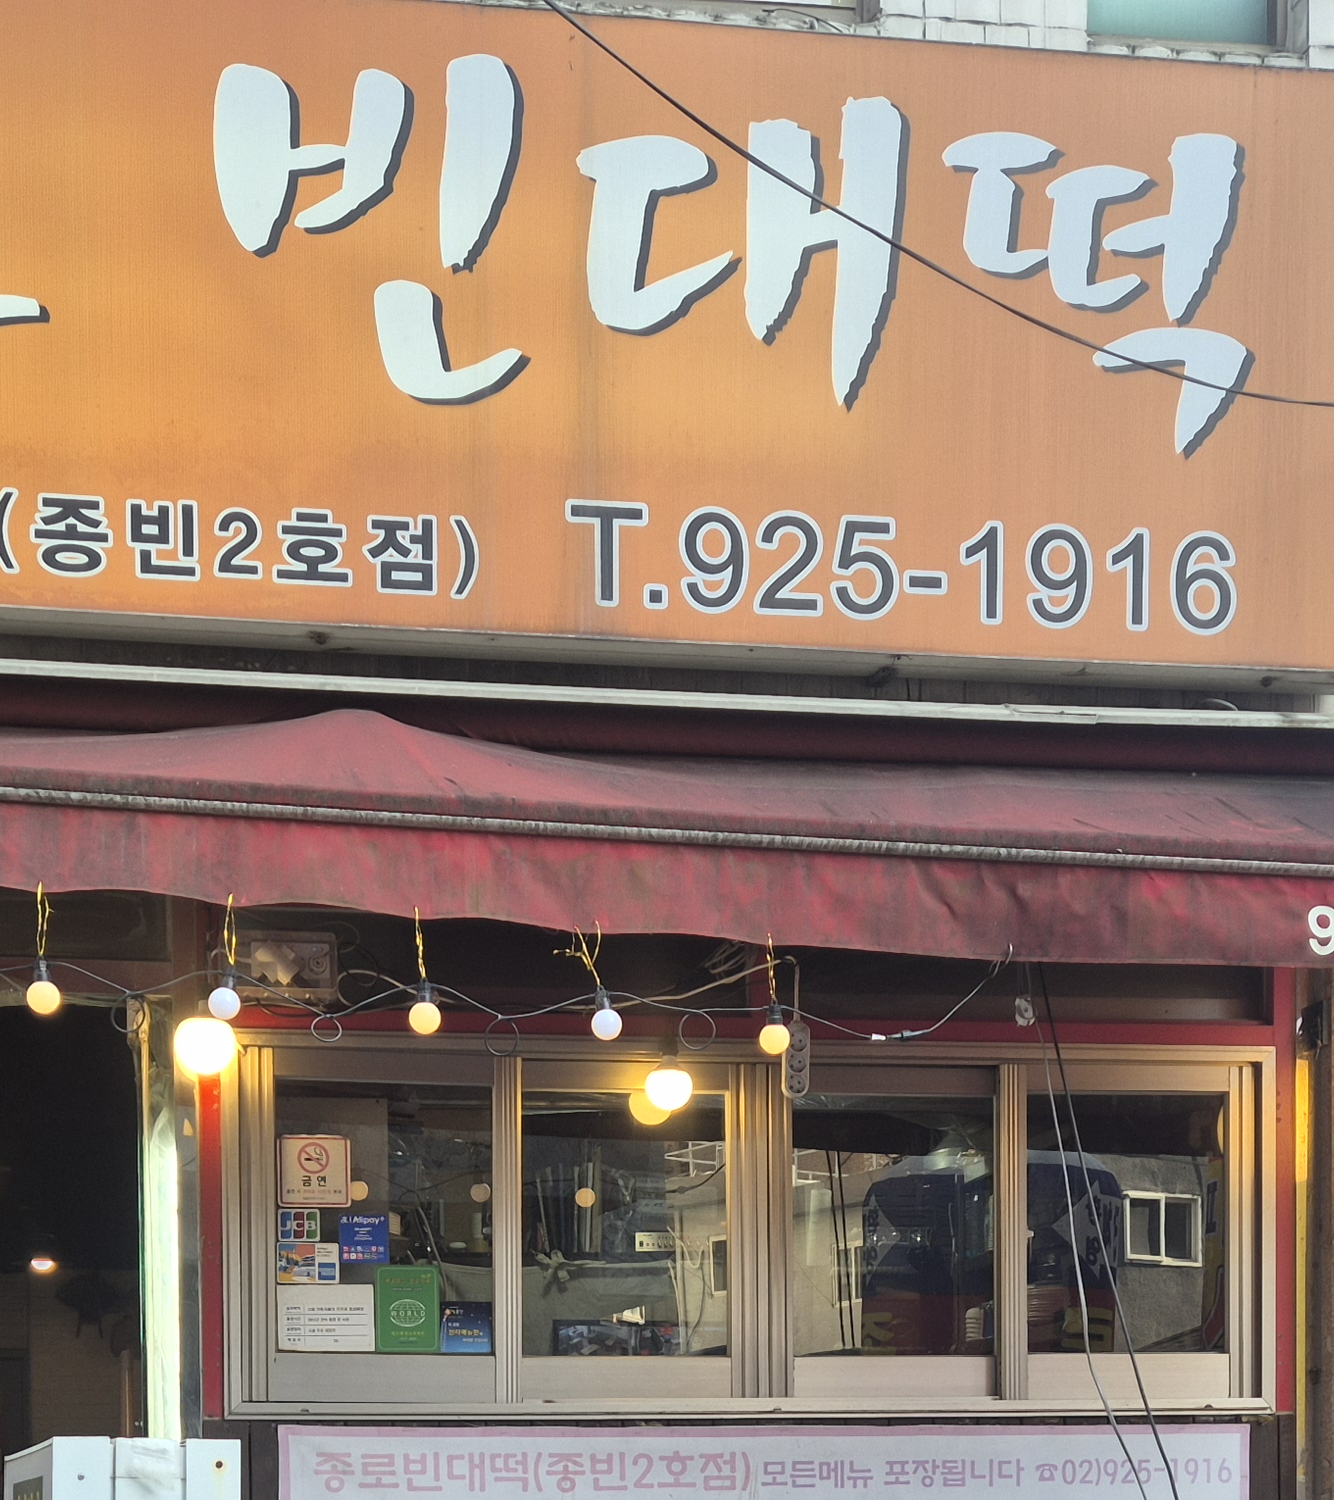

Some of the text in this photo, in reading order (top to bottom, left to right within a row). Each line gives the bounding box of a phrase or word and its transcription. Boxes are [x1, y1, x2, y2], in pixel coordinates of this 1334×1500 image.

[213, 53, 1253, 457] 빈대떡
[567, 498, 1239, 635] T.925-1916
[280, 1220, 317, 1231] JCB
[313, 1450, 752, 1492] 종로빈대떡(종빈2호점)
[761, 1459, 874, 1490] 모든메뉴
[884, 1458, 1024, 1488] 포장됩니다
